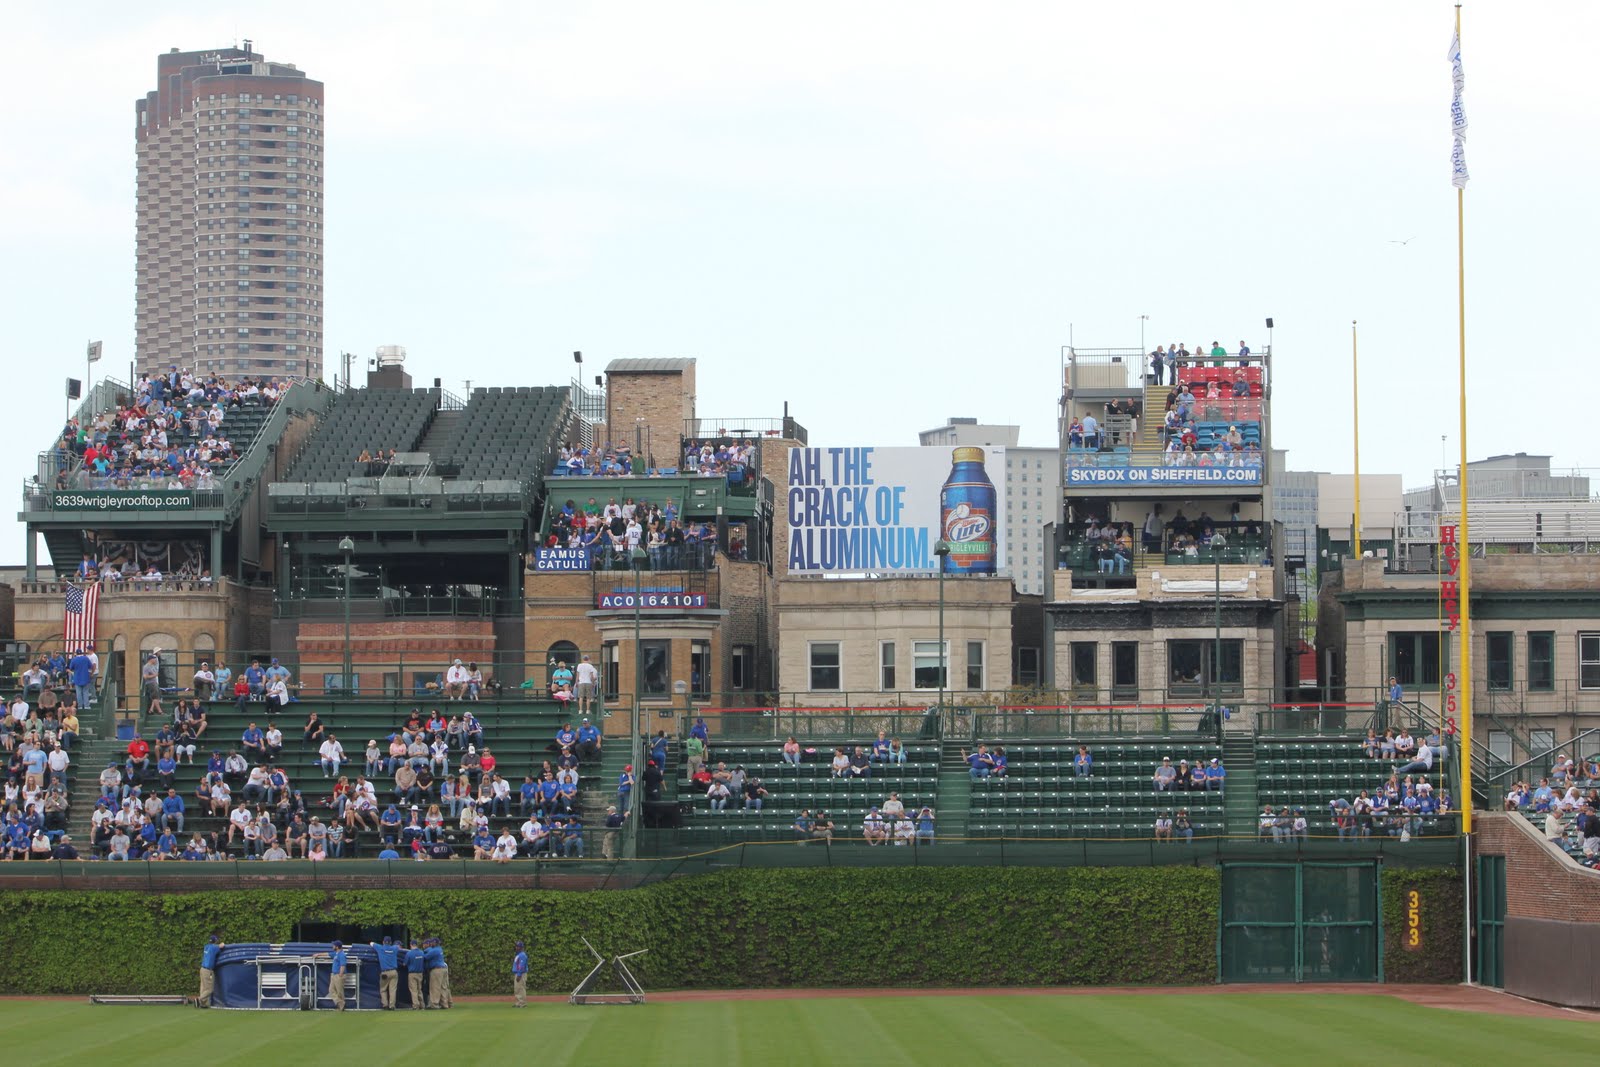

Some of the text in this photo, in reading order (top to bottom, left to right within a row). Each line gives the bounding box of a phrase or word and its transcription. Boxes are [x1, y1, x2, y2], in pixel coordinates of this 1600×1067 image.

[789, 447, 874, 489] AH, THE
[1071, 468, 1256, 481] SKYBOX ON SHEFFIELD.COM
[55, 495, 190, 509] 3639wrigleyrooftop.com
[788, 486, 906, 527] CRACK OF
[538, 560, 588, 569] CATULI!
[540, 550, 586, 559] EAMUS
[788, 527, 935, 570] ALUMINUM.
[1439, 526, 1461, 631] Hey Hey
[1446, 672, 1457, 735] 353
[1408, 890, 1419, 946] 353
